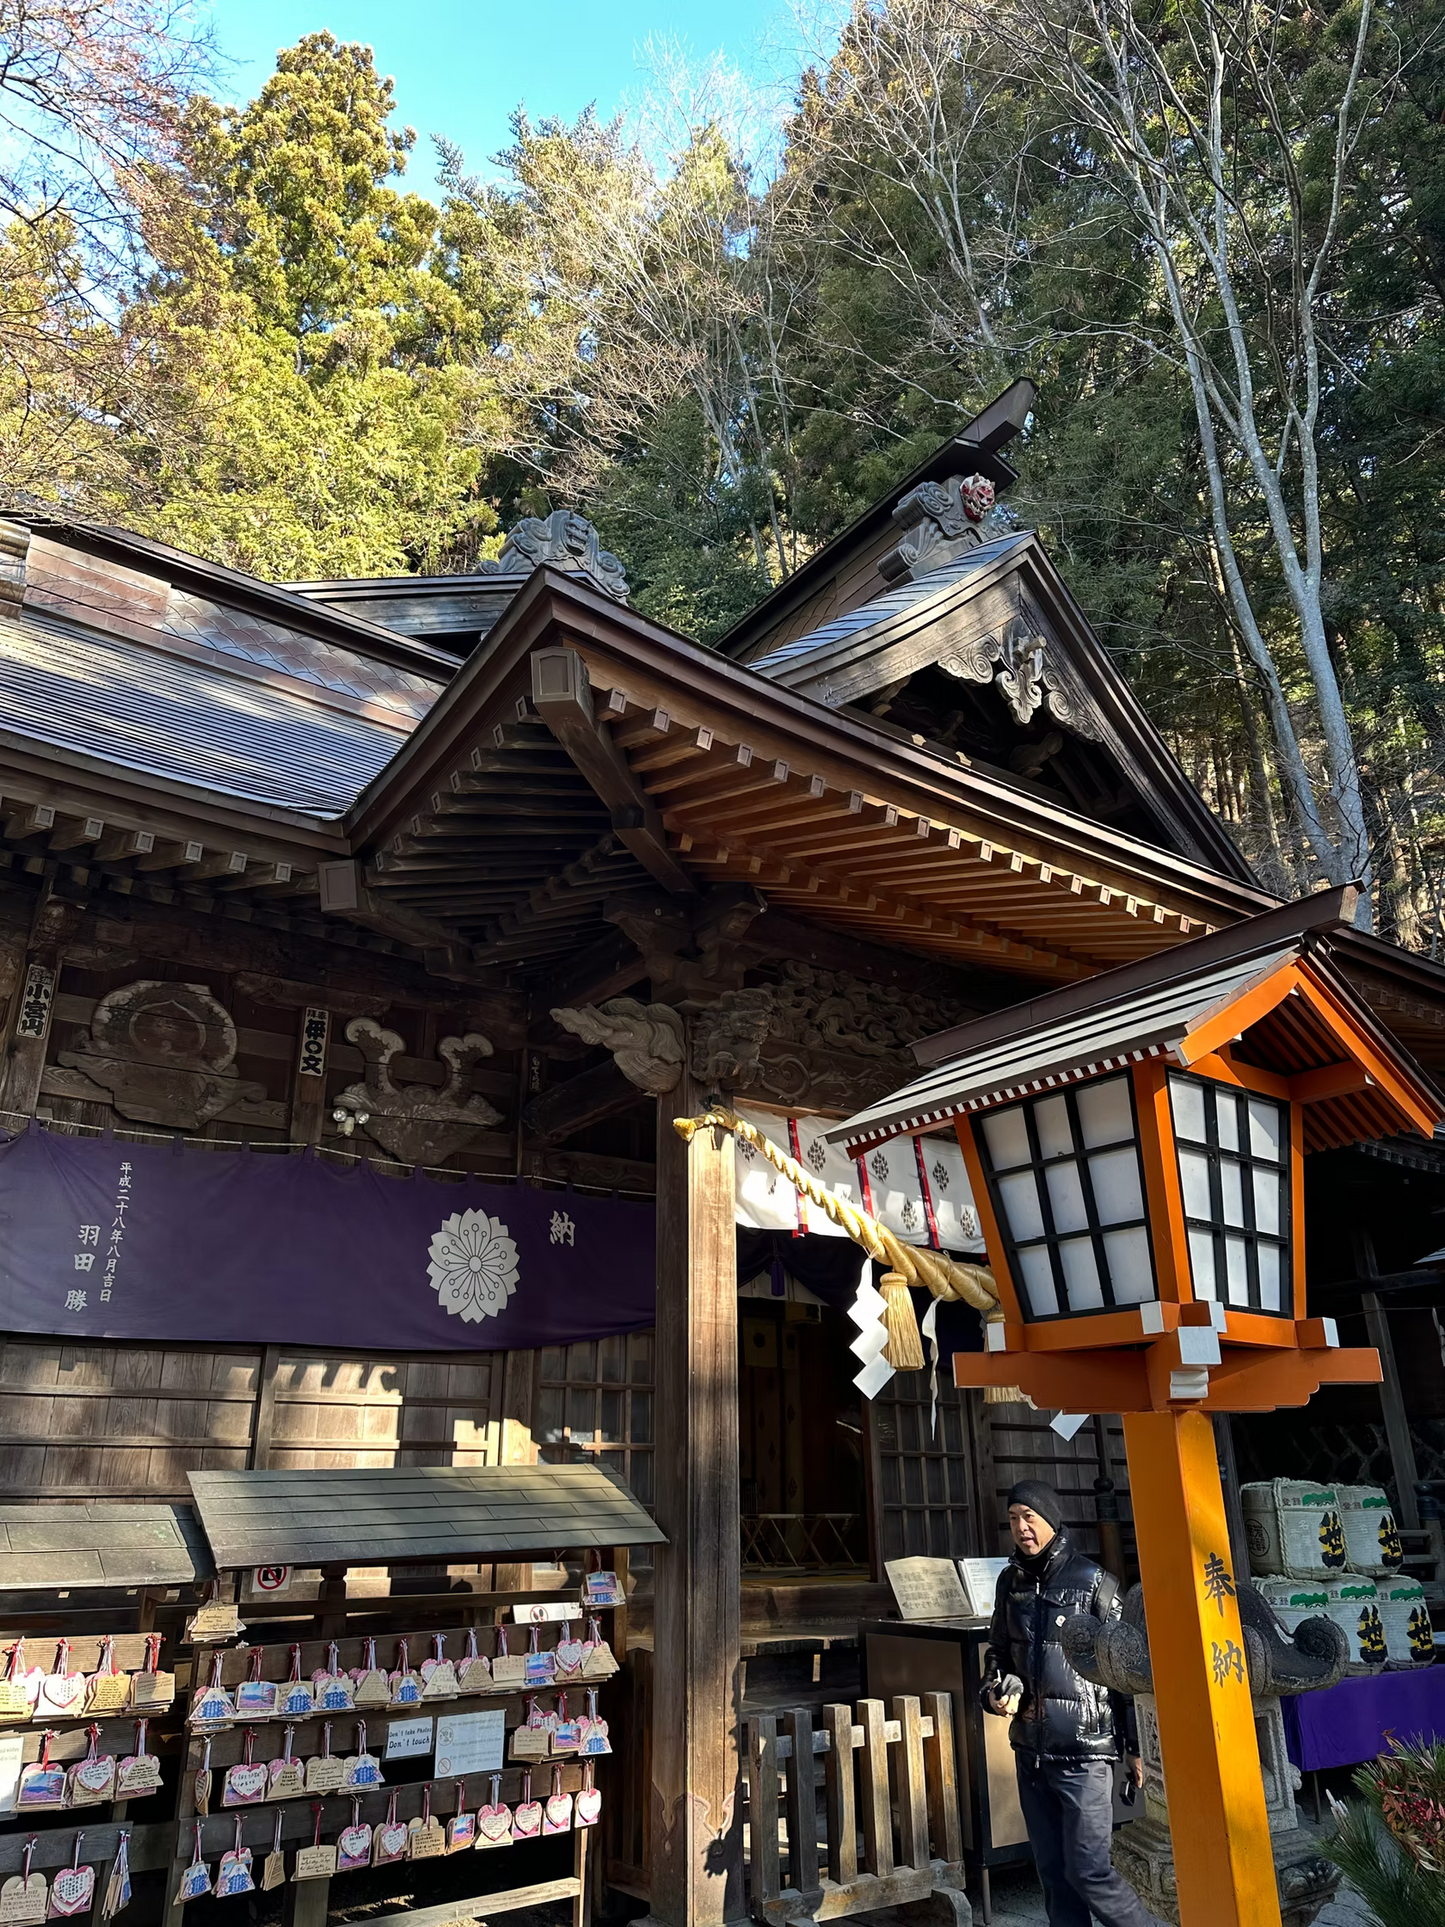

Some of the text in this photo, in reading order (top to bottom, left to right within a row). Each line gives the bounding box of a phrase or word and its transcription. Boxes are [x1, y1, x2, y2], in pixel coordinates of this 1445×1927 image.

[64, 1225, 101, 1312] 羽田勝
[100, 1162, 133, 1302] 平成二十八年八月吉日
[549, 1210, 576, 1247] 納
[1203, 1551, 1245, 1687] 奉納
[389, 1736, 430, 1749] Don't touch
